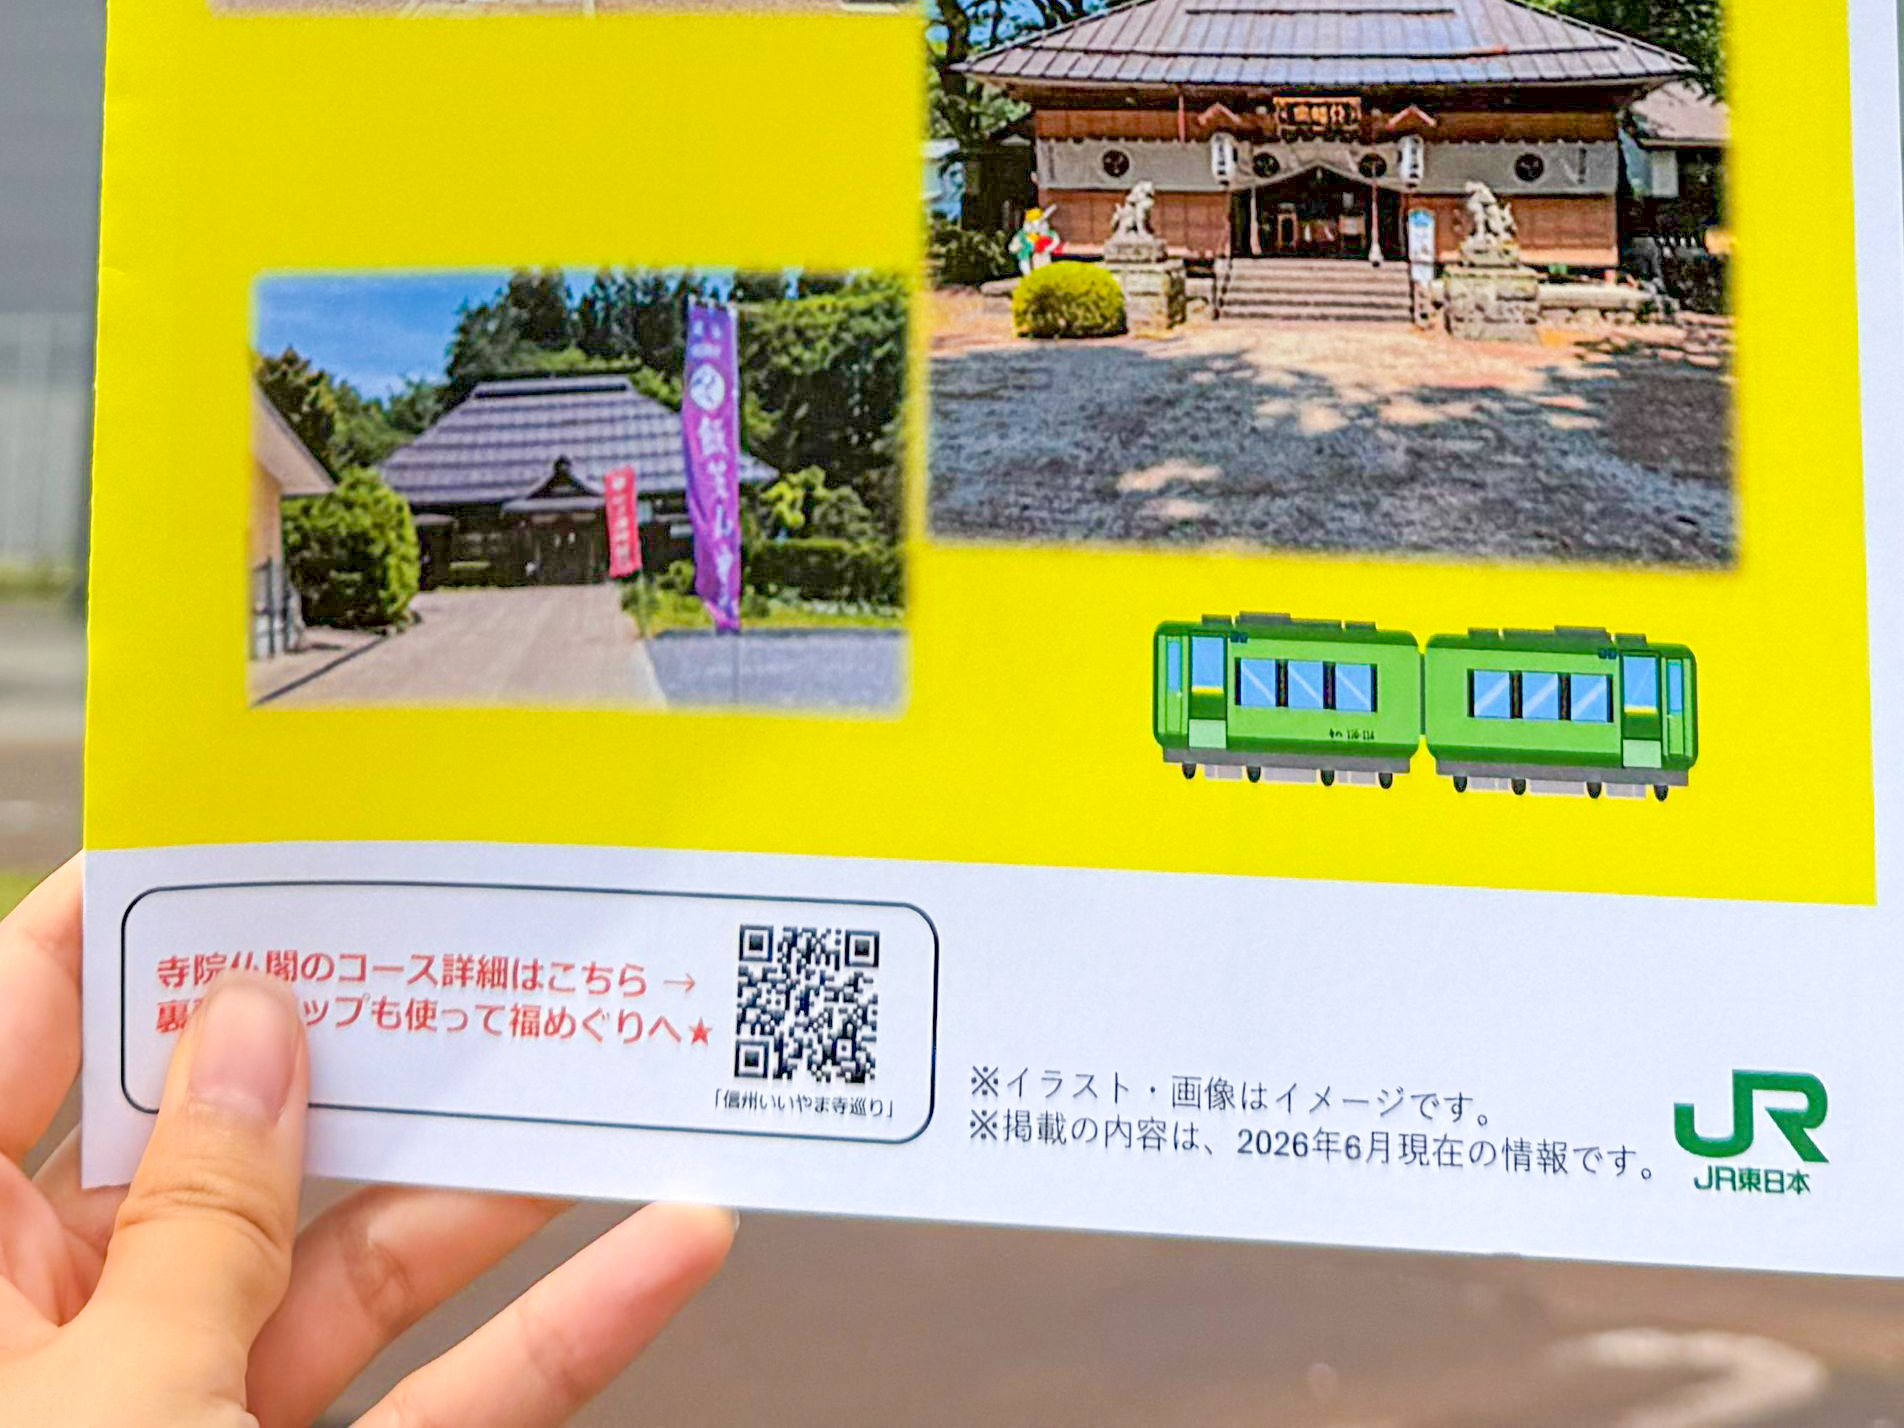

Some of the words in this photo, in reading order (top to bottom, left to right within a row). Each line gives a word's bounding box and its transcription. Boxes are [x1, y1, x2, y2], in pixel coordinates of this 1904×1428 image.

[1673, 1069, 1829, 1164] JR
[1693, 1165, 1810, 1195] JR東日本
